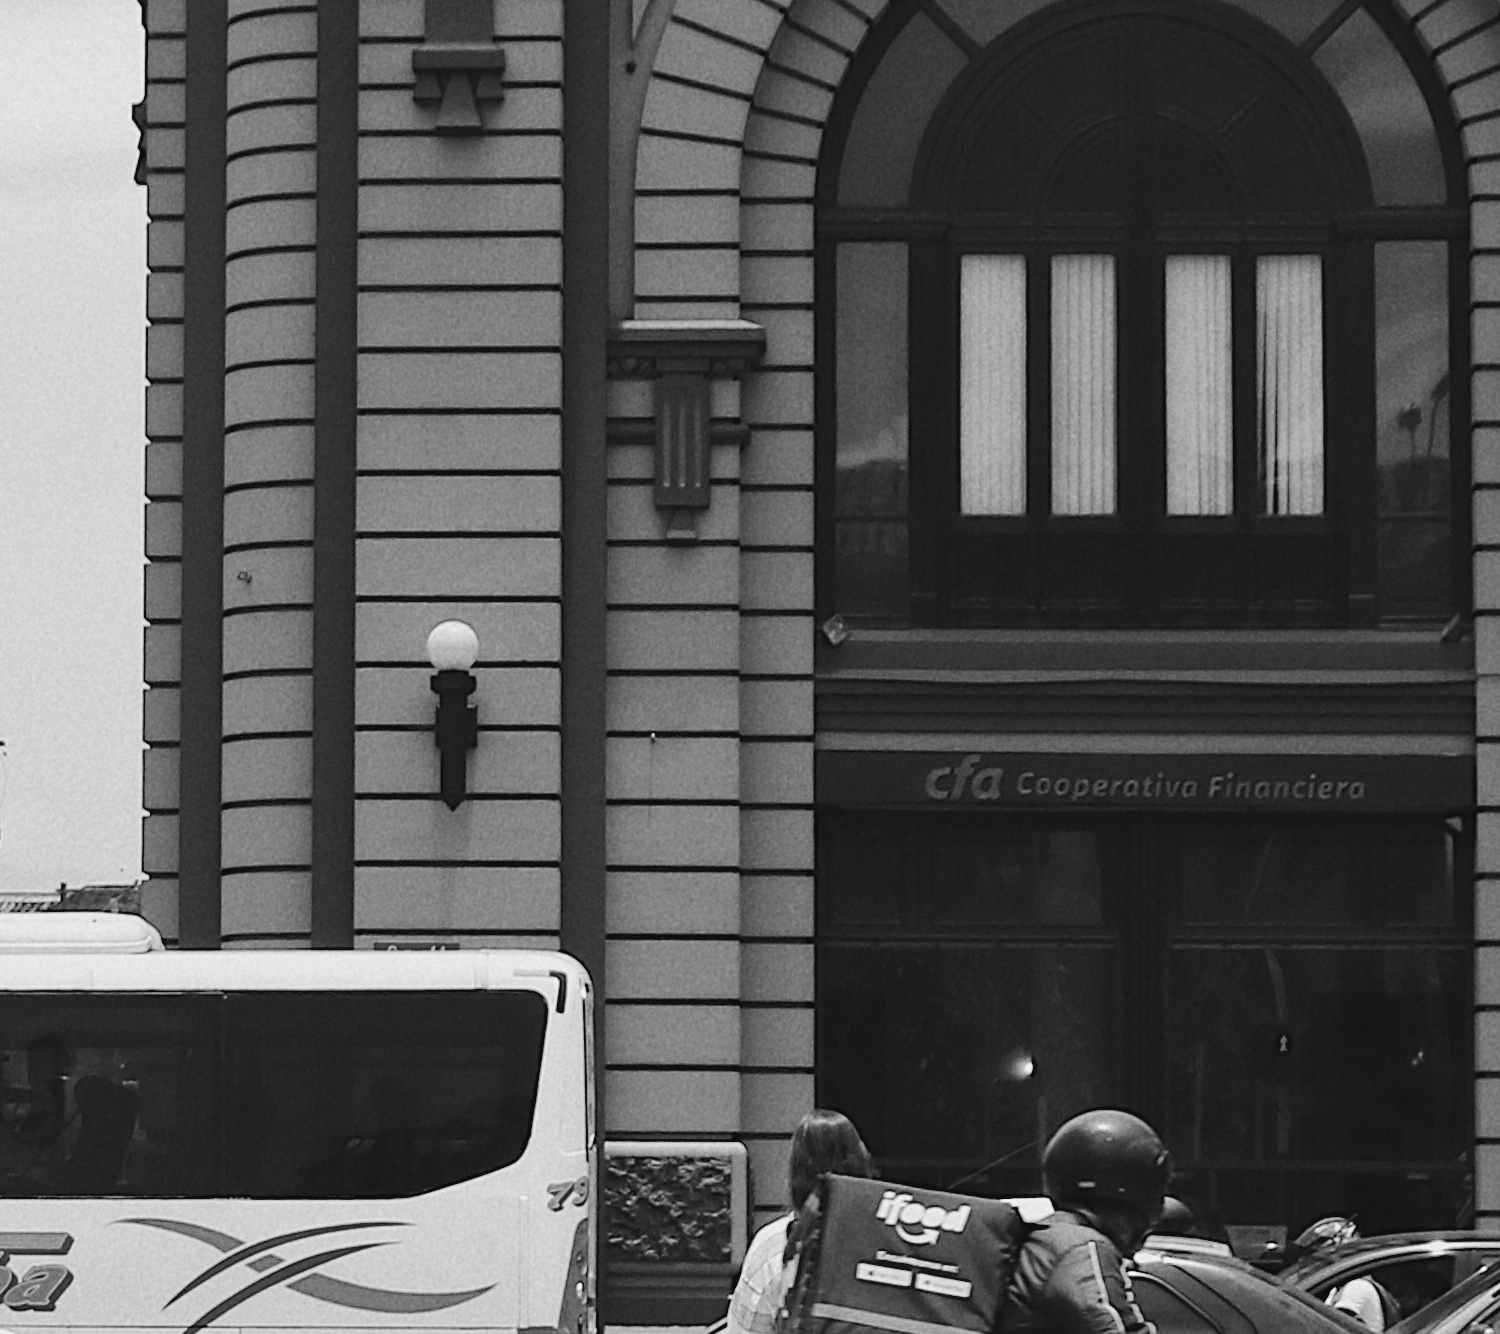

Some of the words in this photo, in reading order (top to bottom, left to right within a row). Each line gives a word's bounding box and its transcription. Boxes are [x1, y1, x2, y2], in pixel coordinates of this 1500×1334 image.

[925, 751, 1002, 802] cfa
[1017, 770, 1199, 805] Cooperativa
[1208, 771, 1366, 801] Financiera
